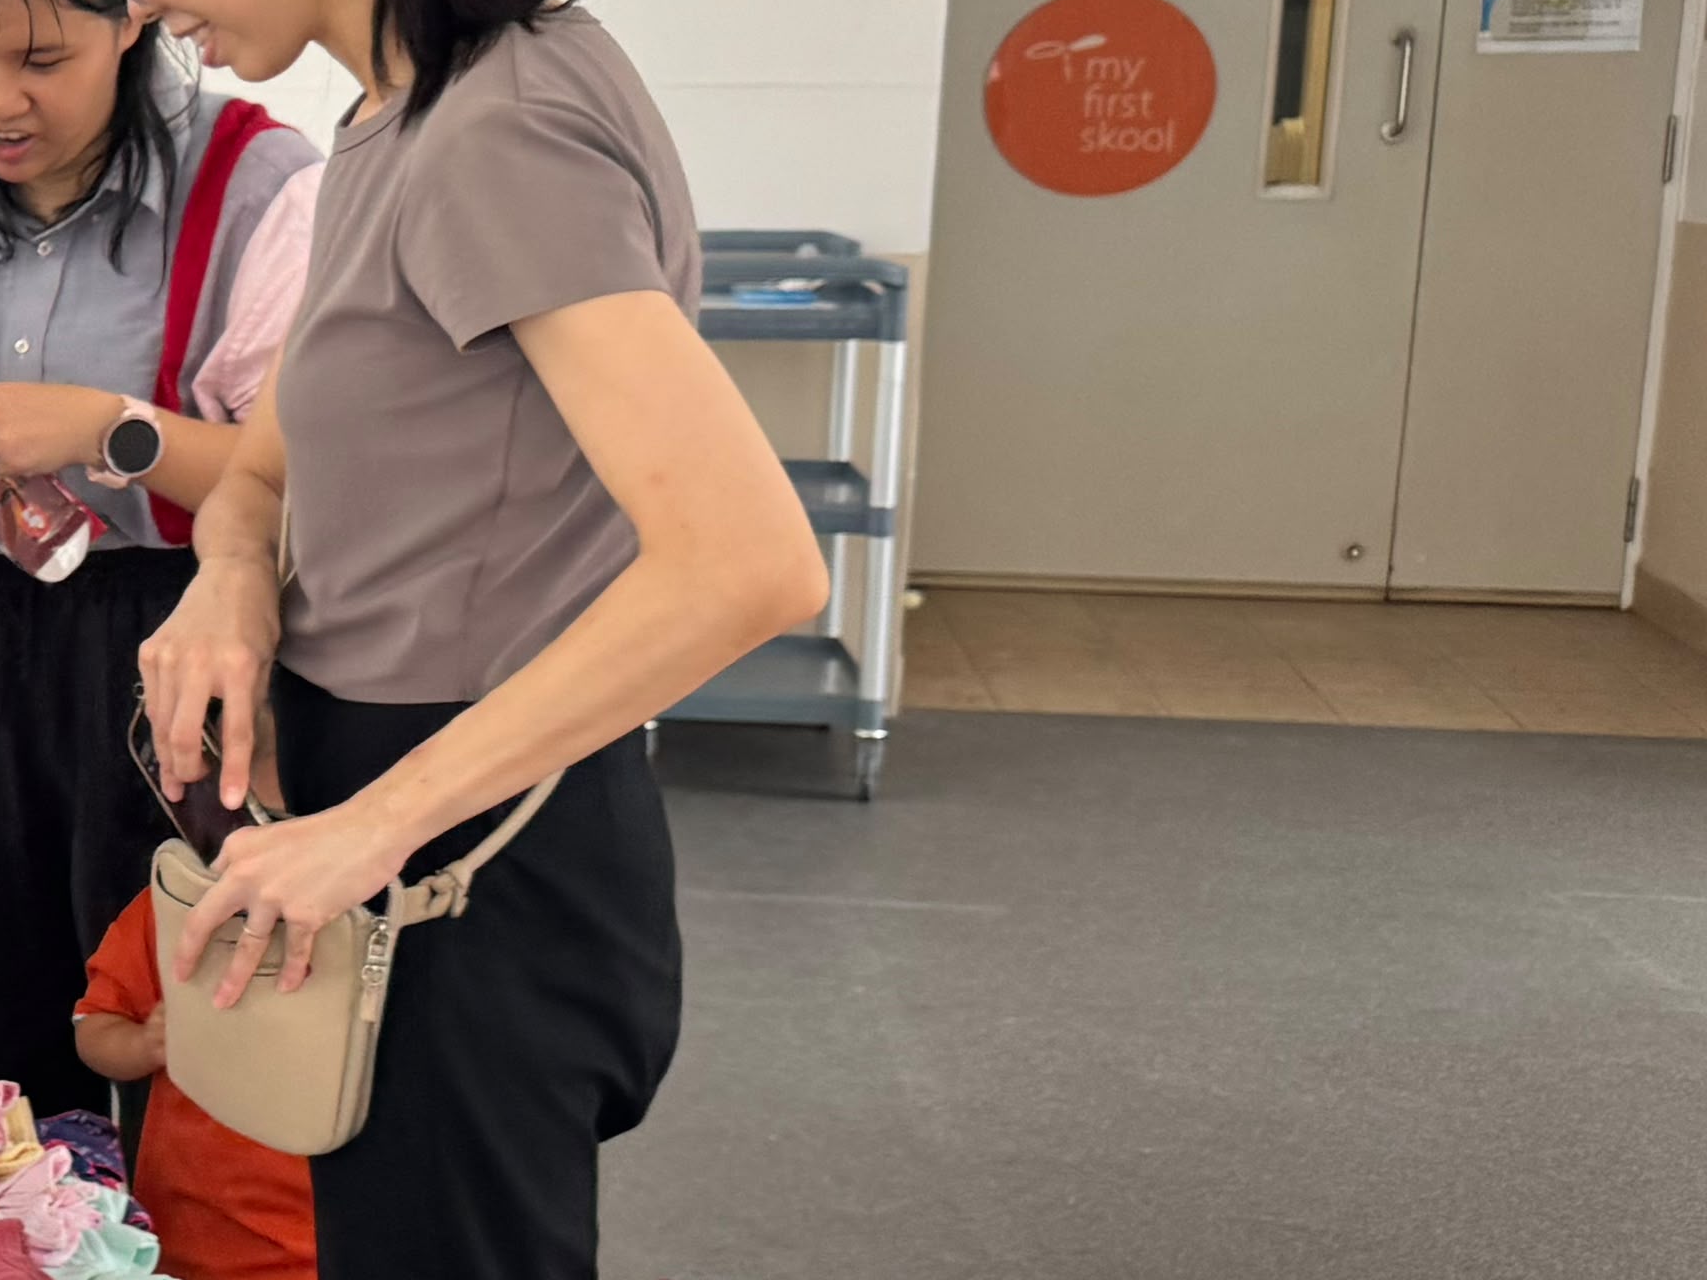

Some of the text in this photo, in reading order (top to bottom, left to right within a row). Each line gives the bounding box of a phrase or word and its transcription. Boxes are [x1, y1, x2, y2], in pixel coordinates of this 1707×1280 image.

[1086, 56, 1146, 89] my
[1084, 83, 1154, 119] first
[1079, 119, 1177, 154] skool
